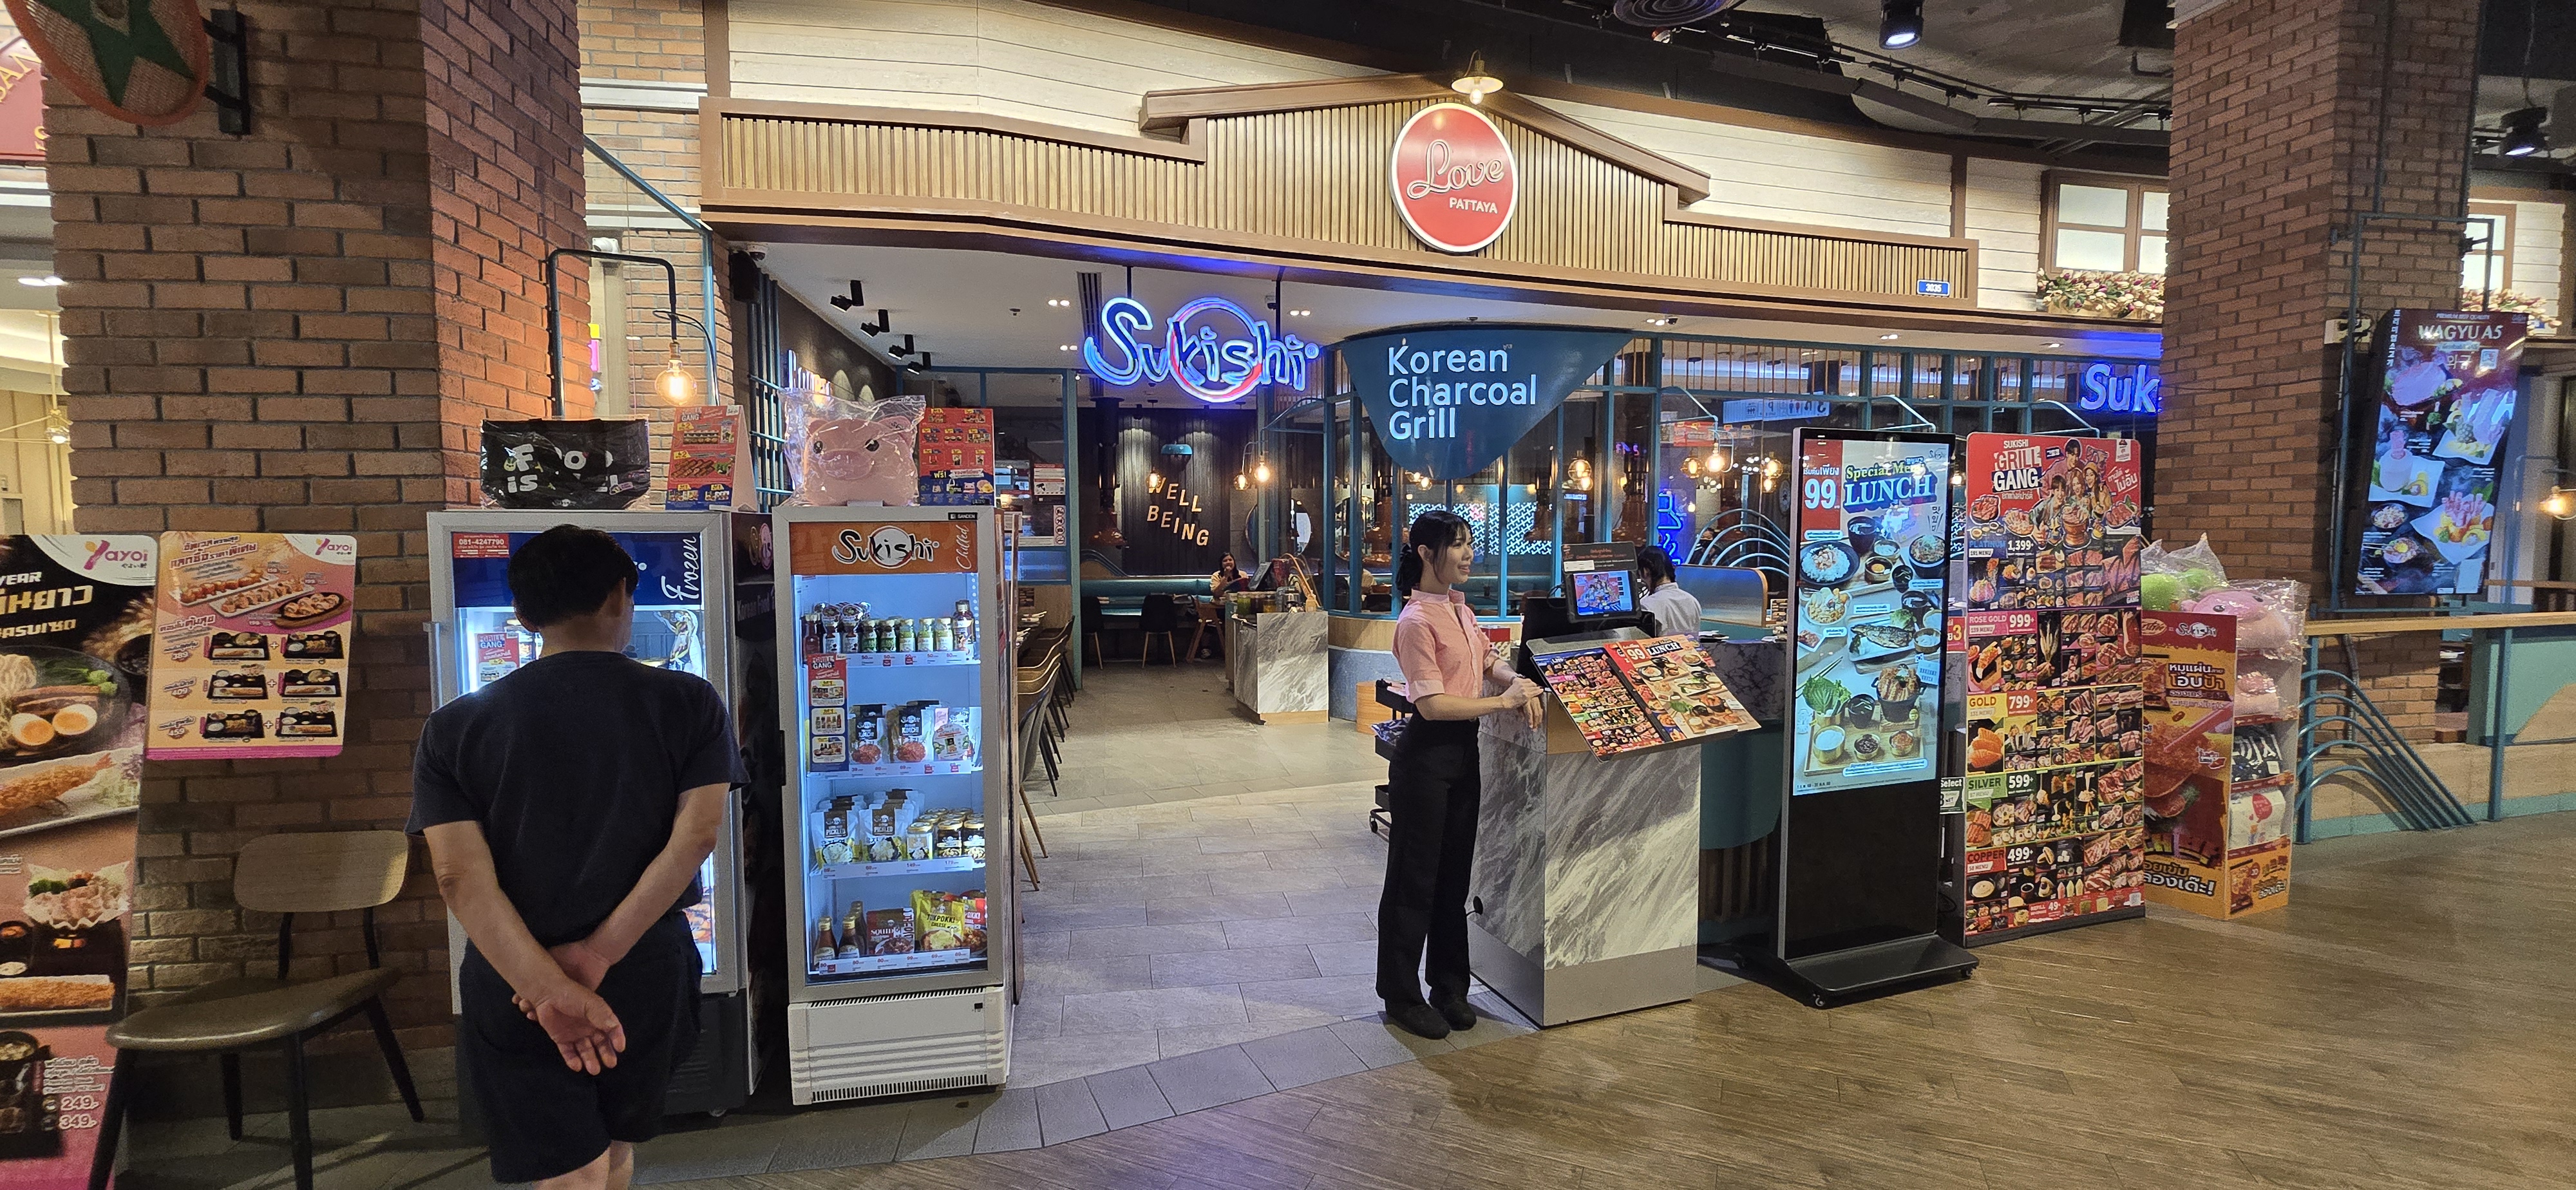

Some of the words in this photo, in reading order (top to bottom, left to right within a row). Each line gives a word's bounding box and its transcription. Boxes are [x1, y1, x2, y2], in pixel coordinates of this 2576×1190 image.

[1406, 138, 1505, 200] Love
[1449, 197, 1498, 214] PATTAYA
[2418, 325, 2479, 339] WAGYU
[2481, 325, 2503, 339] A5
[1084, 298, 1306, 392] Sukishi
[1388, 345, 1508, 375] Korean
[1388, 375, 1537, 408] Charcoal
[1388, 407, 1456, 440] Grill
[2003, 439, 2029, 448] SUKISHI
[1997, 447, 2040, 470] GRILL
[1844, 474, 1932, 506] LUNCH
[1993, 468, 2038, 491] GANG
[1804, 478, 1836, 509] 99
[1146, 505, 1210, 546] BEING
[84, 540, 149, 571] Yayoi
[315, 538, 352, 556] Yayoi
[833, 528, 935, 563] Sukishi
[956, 525, 970, 570] Chilled
[661, 536, 696, 602] Frozen
[2176, 623, 2217, 638] Sukishi
[1626, 648, 1647, 660] 99
[1646, 643, 1681, 656] LUNCH
[2169, 661, 2211, 675] หมูแผ่น
[1969, 696, 1997, 707] GOLD
[1968, 777, 2002, 789] SILVER
[1967, 849, 2005, 863] COPPER
